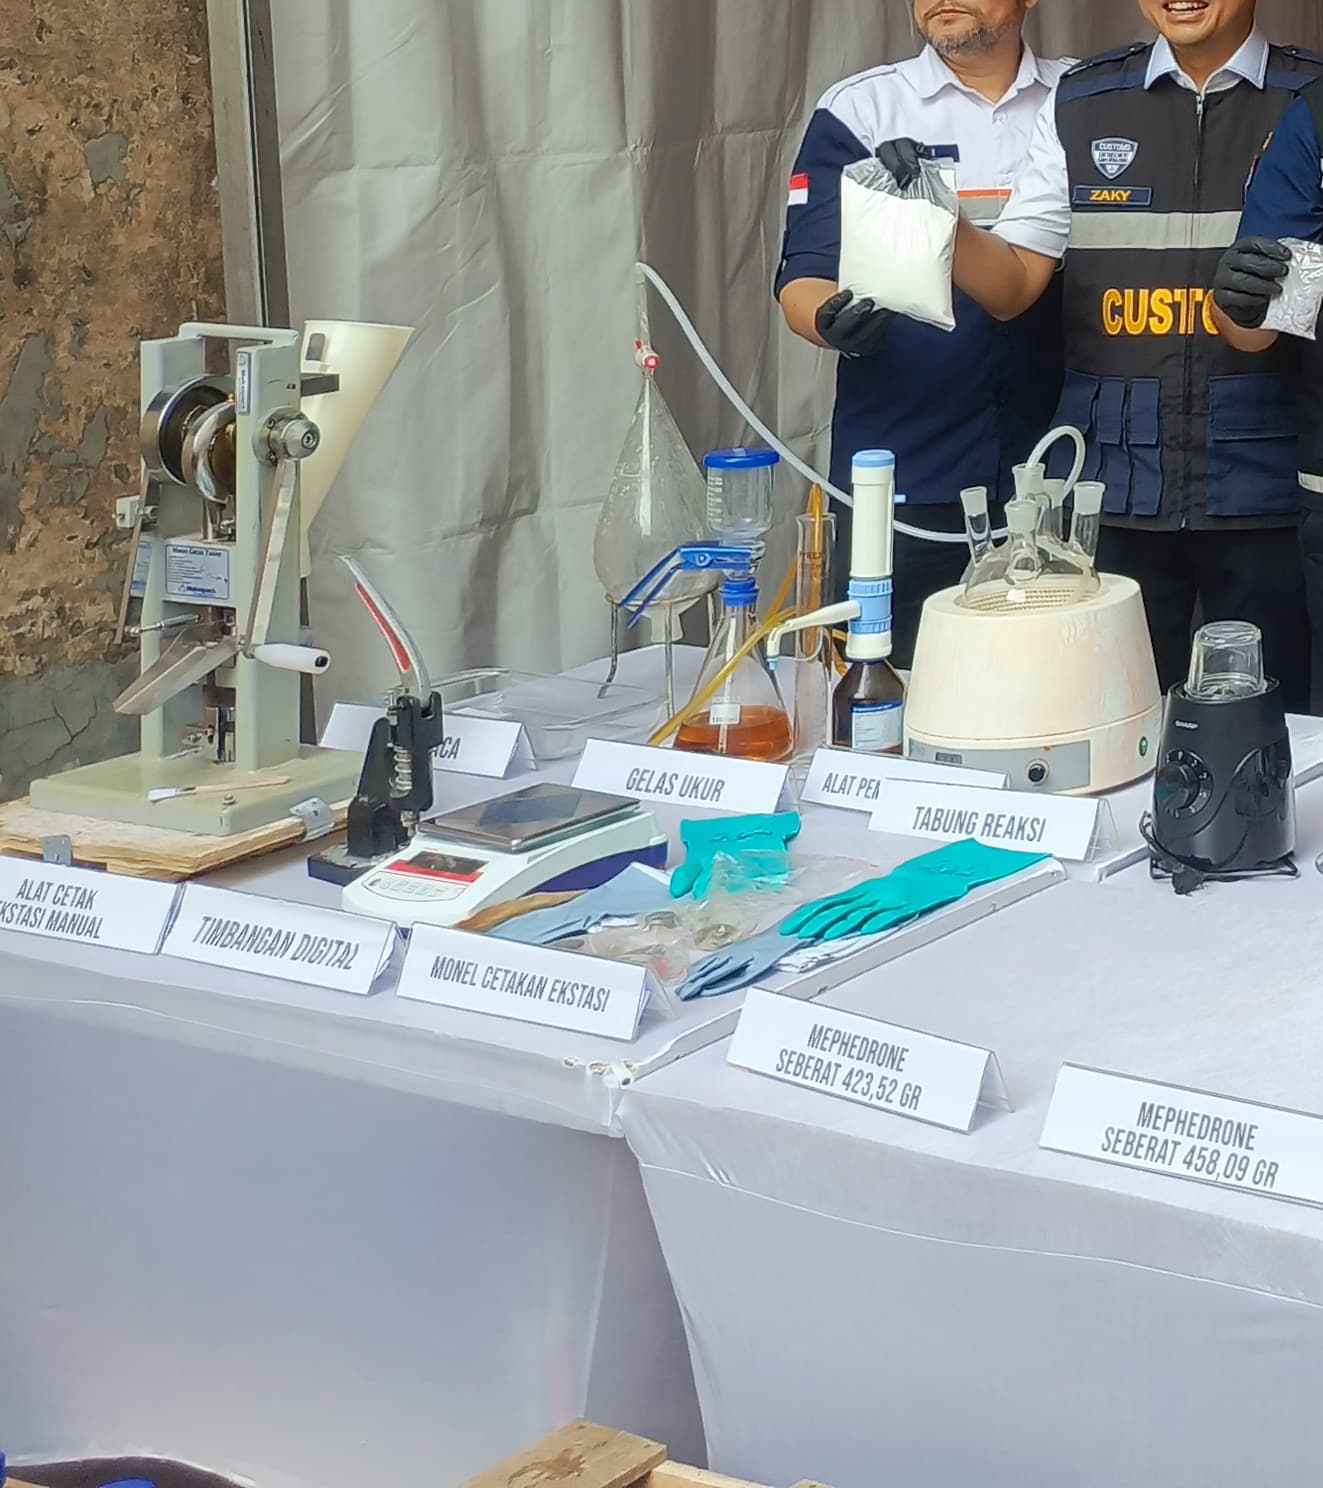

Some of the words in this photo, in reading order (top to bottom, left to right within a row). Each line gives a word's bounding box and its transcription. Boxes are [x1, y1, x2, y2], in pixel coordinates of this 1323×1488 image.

[1089, 189, 1132, 201] ZAKY
[625, 766, 677, 798] GELAS
[677, 773, 726, 803] UKUR
[821, 770, 856, 795] ALAT
[913, 803, 979, 840] TABUNG
[981, 812, 1047, 844] REAKSI
[16, 878, 54, 903] ALAT
[52, 884, 98, 911] CETAK
[44, 909, 104, 939] MANUAL
[193, 915, 296, 961] TIMBANGAN
[290, 932, 361, 971] DIGITAL
[430, 954, 479, 987] MONEL
[480, 963, 549, 1000] CETAKAN
[547, 976, 611, 1013] EKSTASI
[807, 1023, 910, 1073] MEPHEDRONE
[775, 1048, 843, 1088] SEBERAT
[841, 1067, 899, 1104] 423,52
[898, 1082, 923, 1111] GR
[1136, 1100, 1259, 1152] MEPHEDRONE
[1101, 1125, 1182, 1167] SEBERAT
[1182, 1143, 1251, 1182] 458,09
[1251, 1158, 1280, 1189] GR
